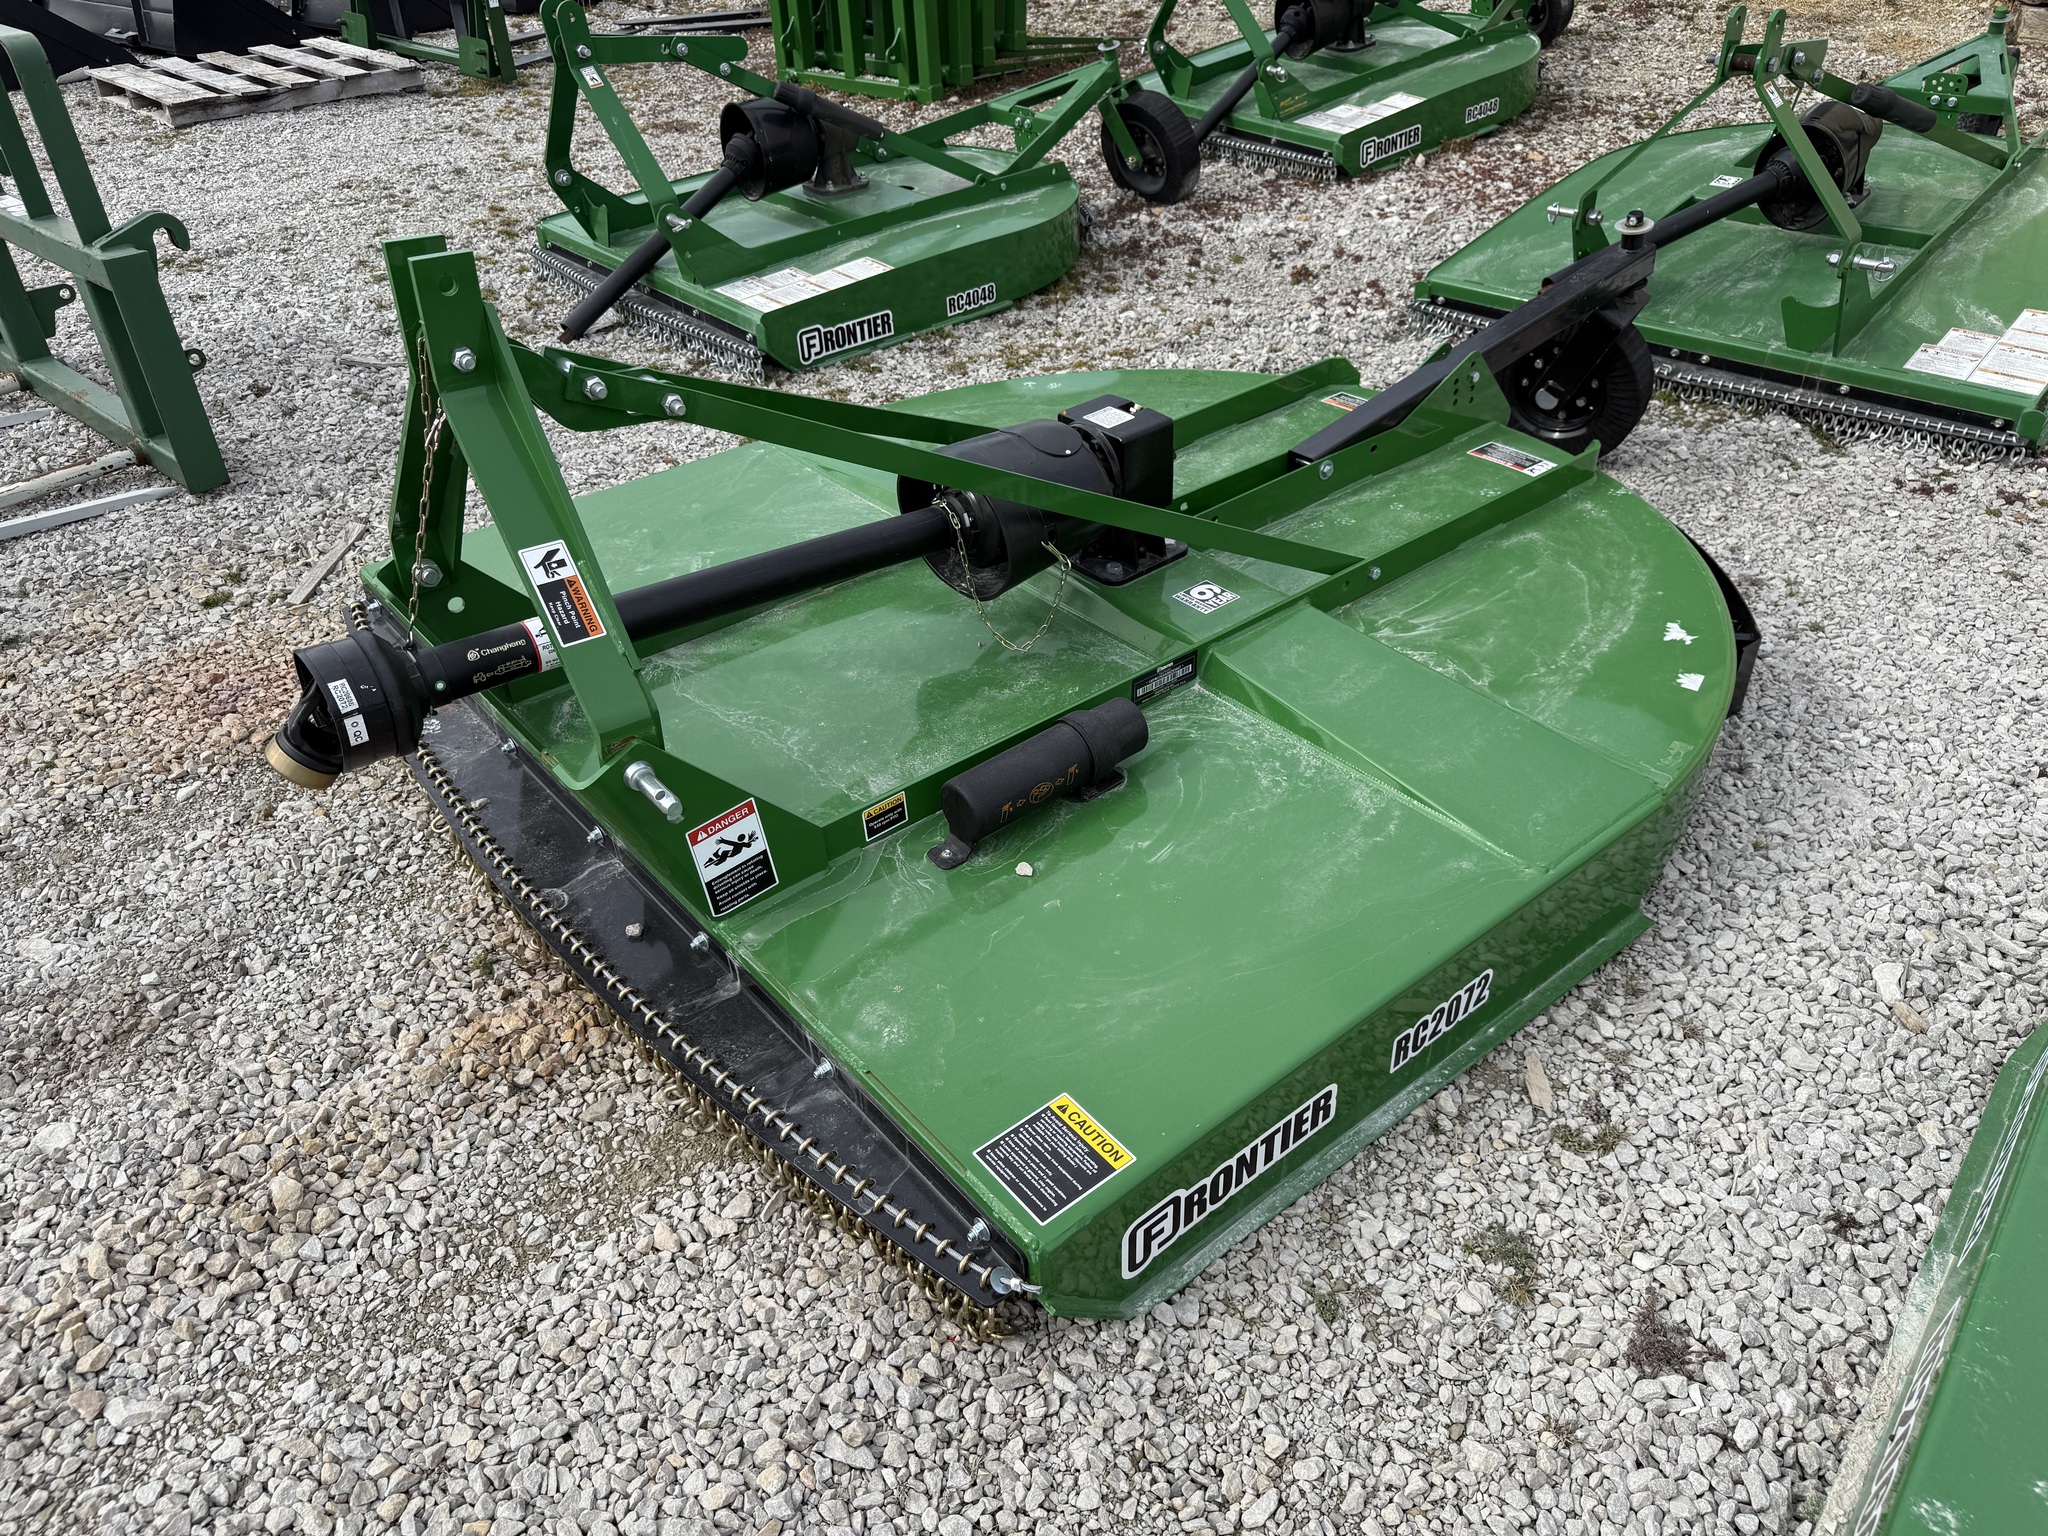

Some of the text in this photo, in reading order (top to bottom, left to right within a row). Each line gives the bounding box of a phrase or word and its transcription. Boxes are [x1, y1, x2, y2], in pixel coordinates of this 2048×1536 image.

[1466, 98, 1499, 123] RC4048
[1361, 125, 1420, 166] FRONTIER
[948, 284, 995, 315] RC4048
[799, 312, 893, 363] FRONTIER
[559, 590, 580, 628] Pinch Point
[1190, 584, 1221, 600] 6
[1205, 591, 1238, 608] YEAR
[555, 601, 570, 624] Hazard
[571, 587, 597, 632] WARNING
[707, 807, 748, 834] DANGER
[873, 796, 902, 814] CAUTION
[1392, 972, 1491, 1070] RC2072
[1068, 1111, 1123, 1161] CAUTION
[1127, 1088, 1333, 1273] FRONTIER
